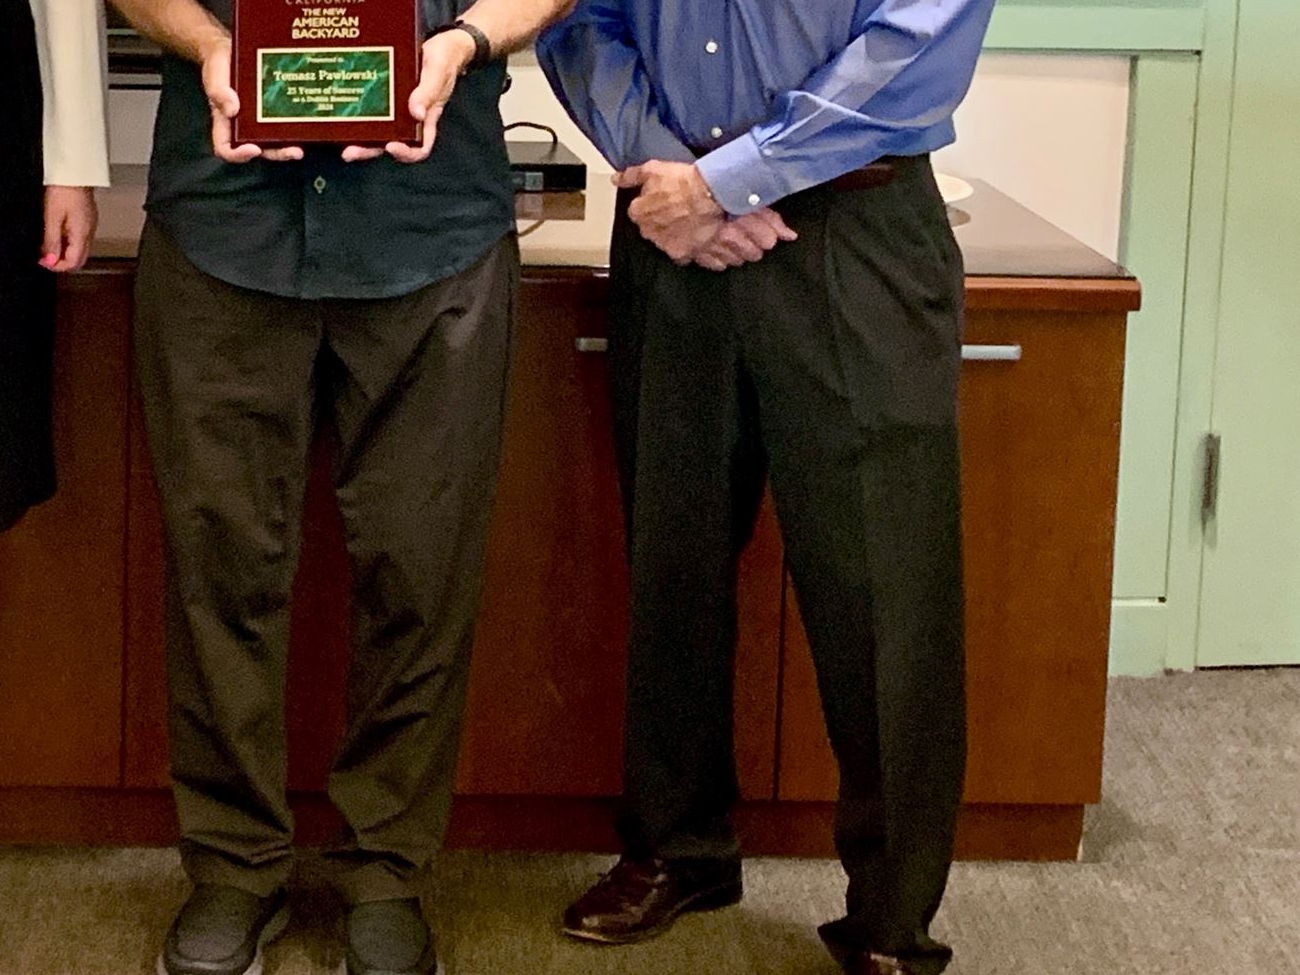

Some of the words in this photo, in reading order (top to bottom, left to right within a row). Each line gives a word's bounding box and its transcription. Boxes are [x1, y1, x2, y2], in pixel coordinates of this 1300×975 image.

[302, 8, 322, 16] THE
[323, 7, 347, 16] NEW
[292, 17, 360, 28] AMERICAN
[291, 28, 361, 39] BACKYARD
[273, 71, 316, 81] Tomasz
[318, 70, 378, 81] Pawlowski
[298, 87, 322, 95] Years
[323, 86, 332, 95] of
